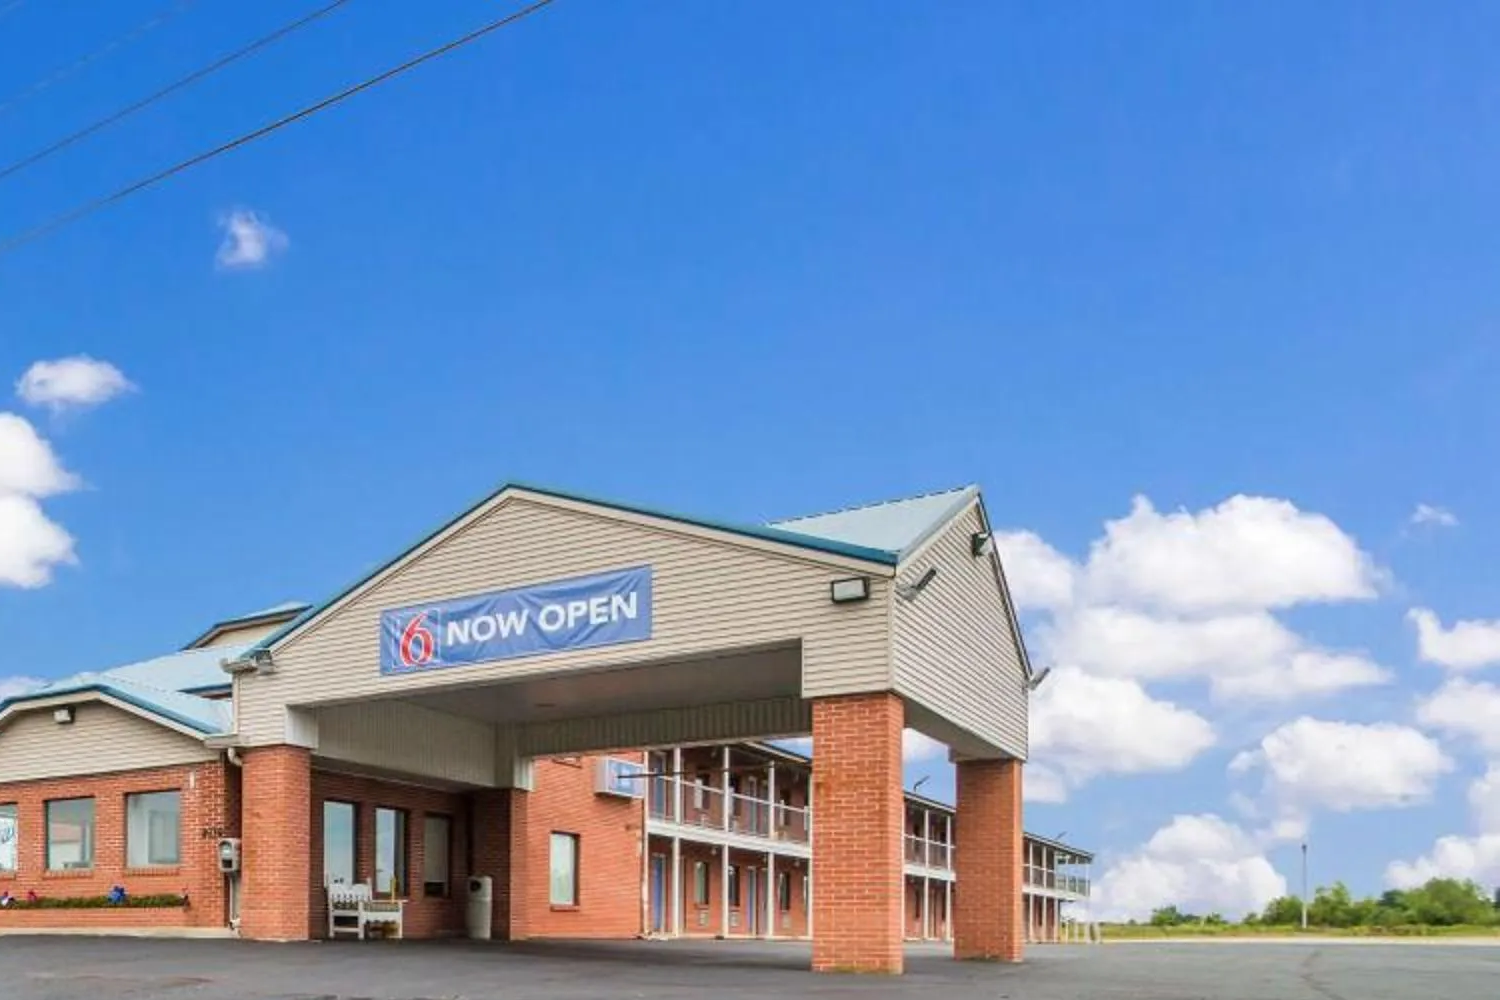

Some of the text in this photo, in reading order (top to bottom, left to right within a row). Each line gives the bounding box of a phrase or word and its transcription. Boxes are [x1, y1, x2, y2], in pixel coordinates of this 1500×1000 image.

[400, 591, 638, 667] 6 NOW OPEN
